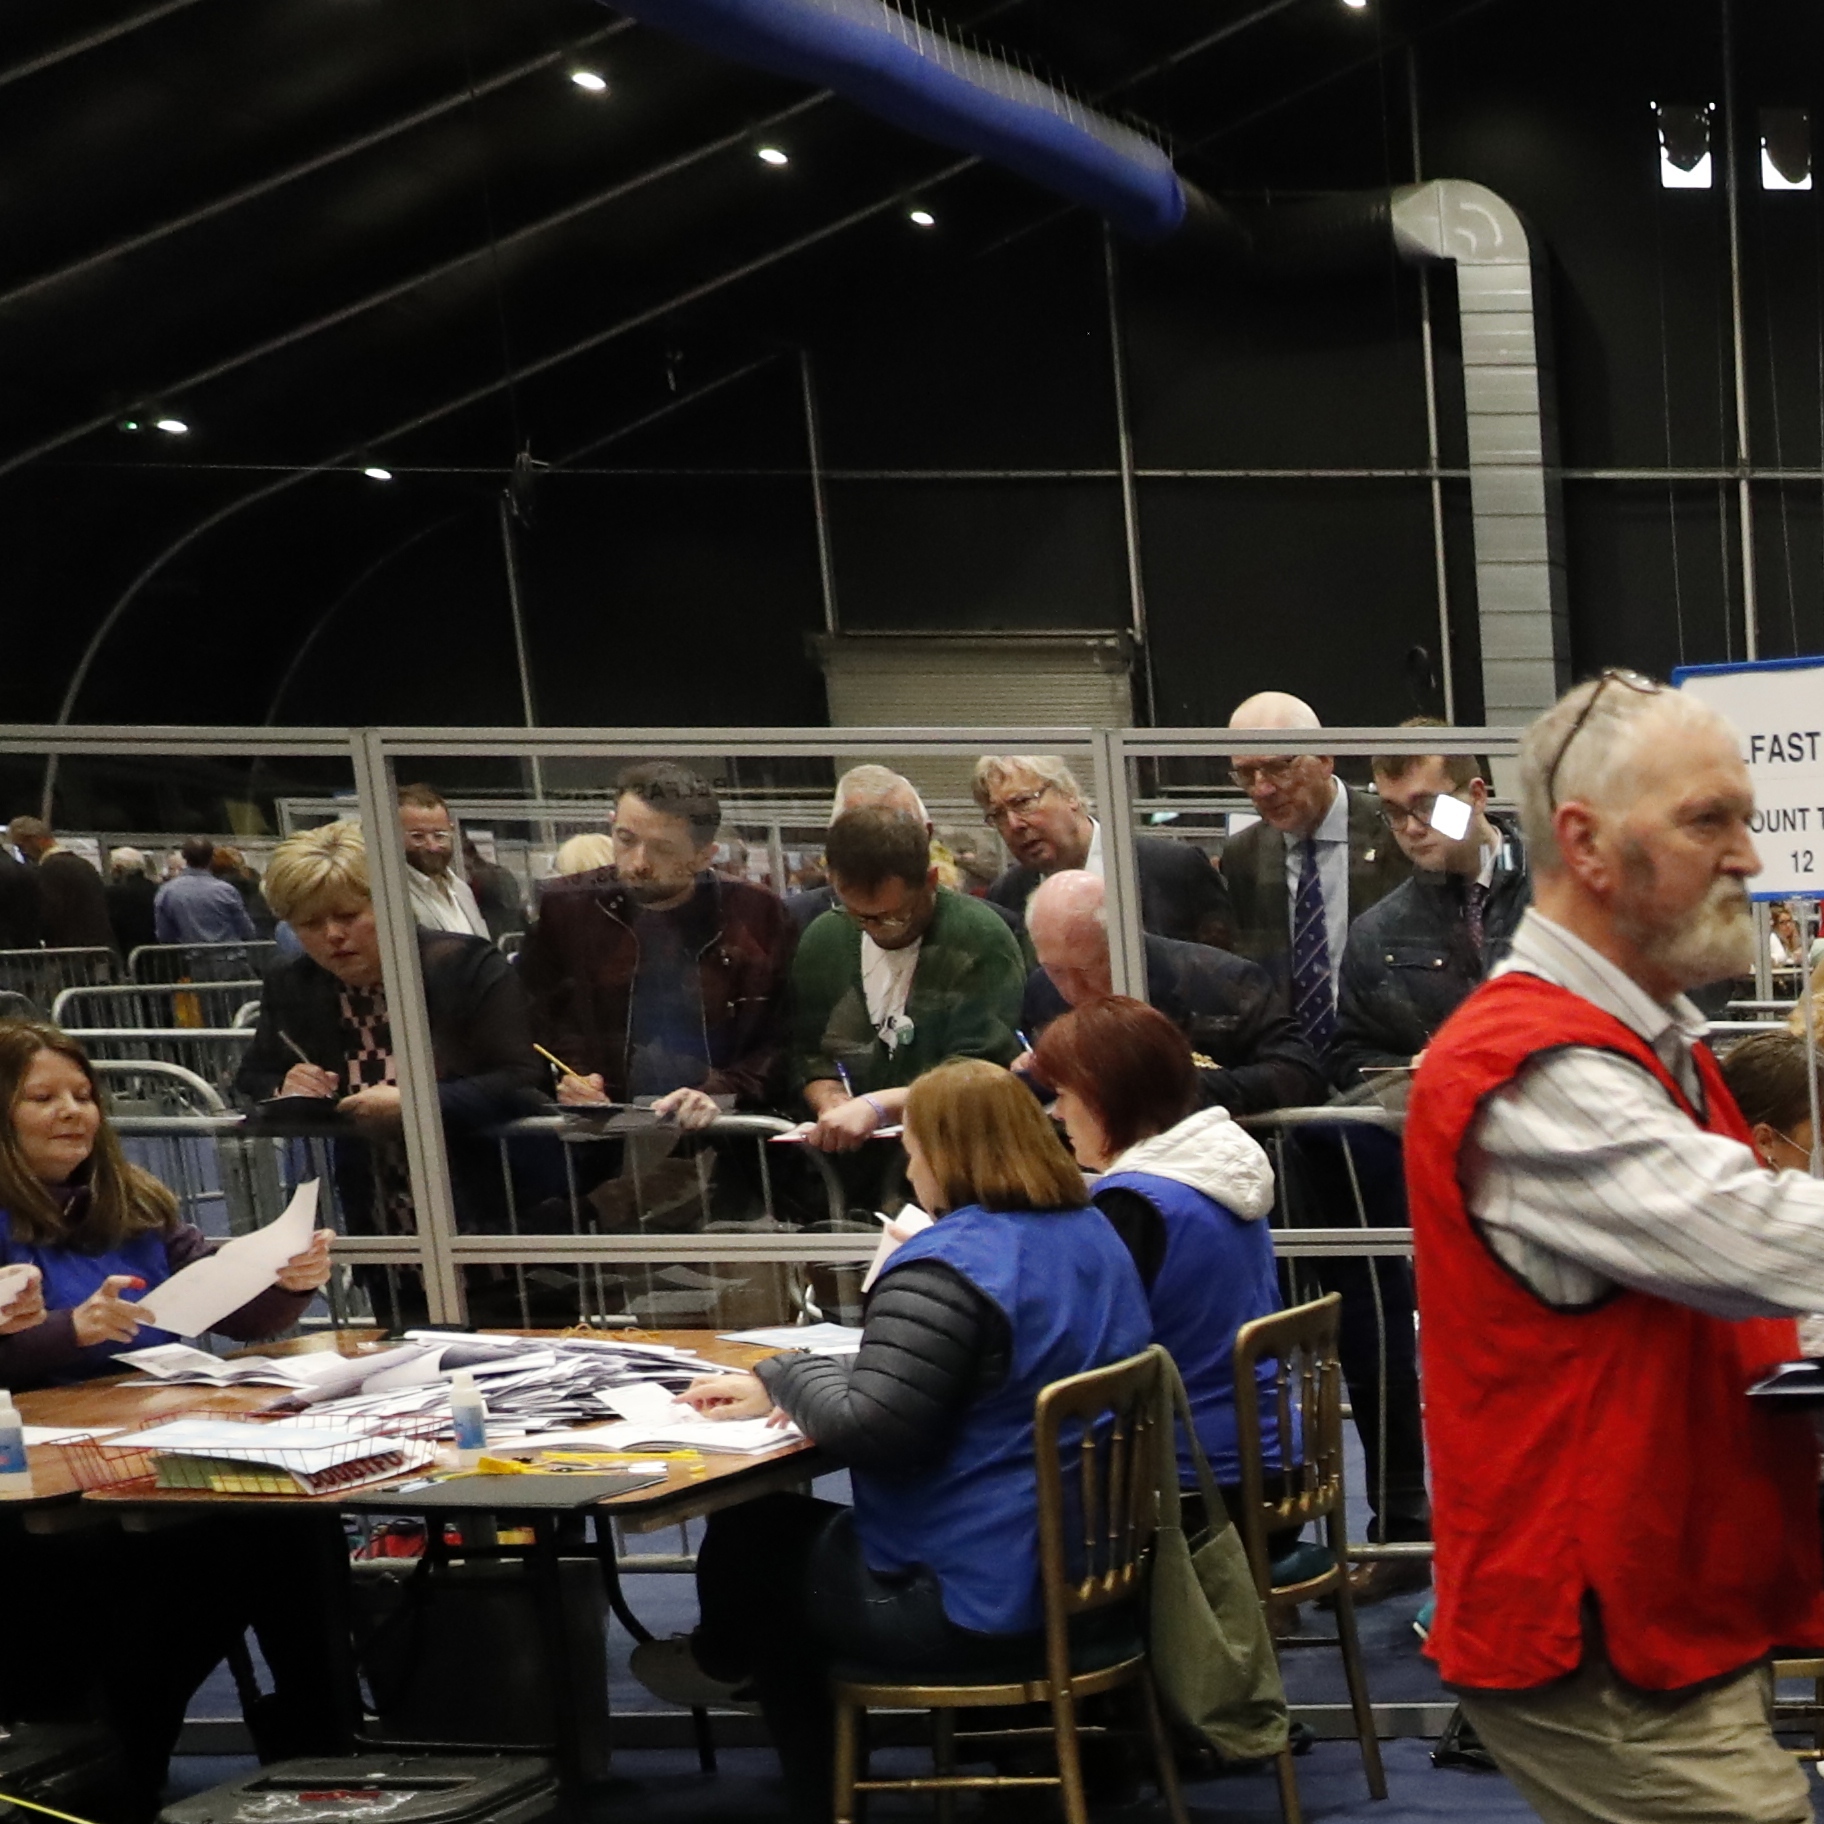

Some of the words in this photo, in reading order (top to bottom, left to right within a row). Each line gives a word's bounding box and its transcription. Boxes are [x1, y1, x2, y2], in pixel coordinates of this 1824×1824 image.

[1743, 727, 1820, 764] FAST
[1751, 807, 1811, 833] OUNT
[1790, 850, 1815, 873] 12
